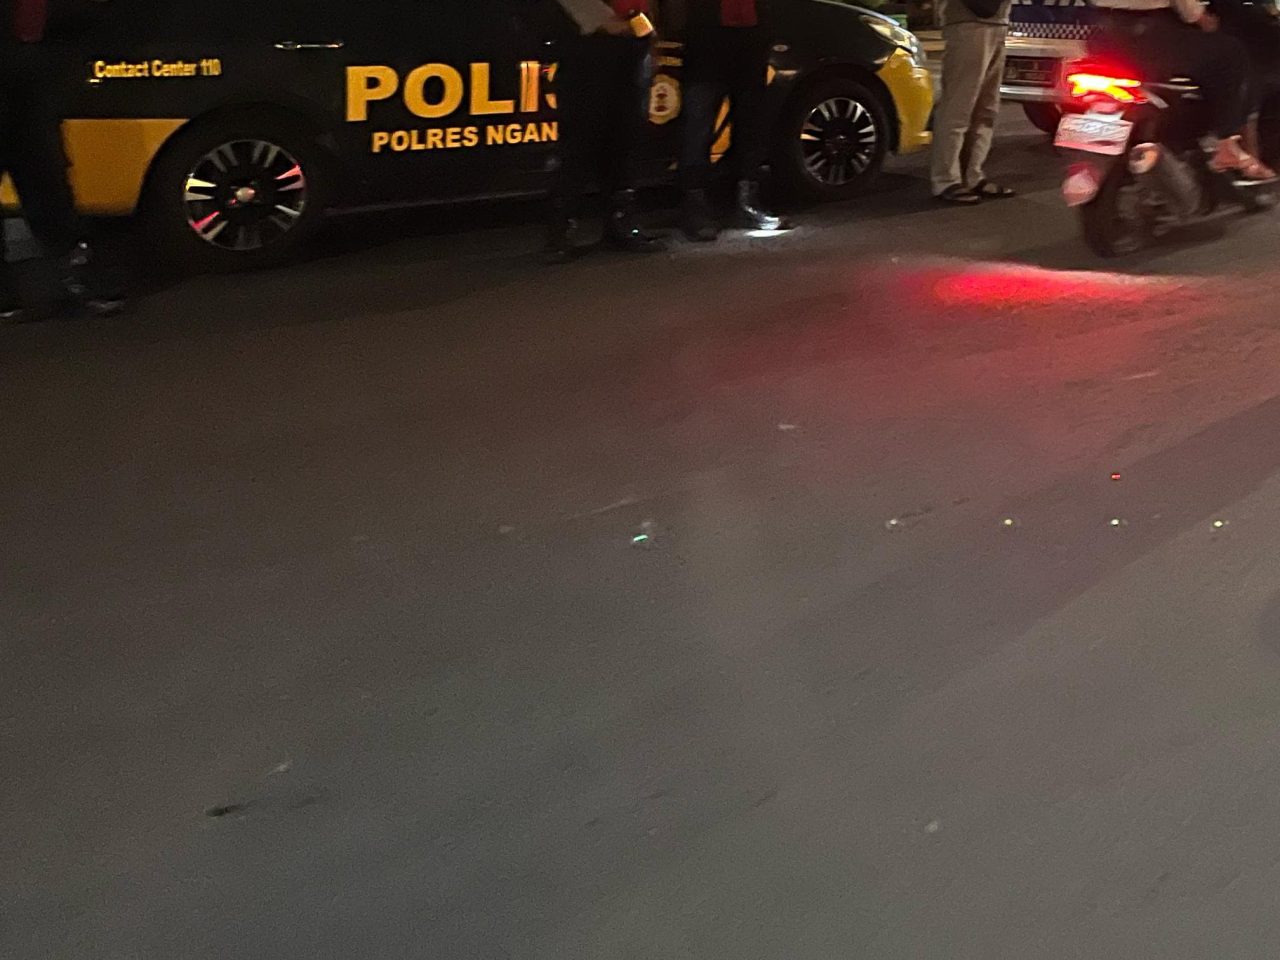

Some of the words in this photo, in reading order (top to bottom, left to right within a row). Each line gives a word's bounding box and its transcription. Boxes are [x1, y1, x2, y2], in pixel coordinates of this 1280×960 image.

[95, 60, 149, 78] Contact
[152, 59, 196, 77] Center
[201, 58, 221, 76] 110
[372, 126, 479, 153] POLRES
